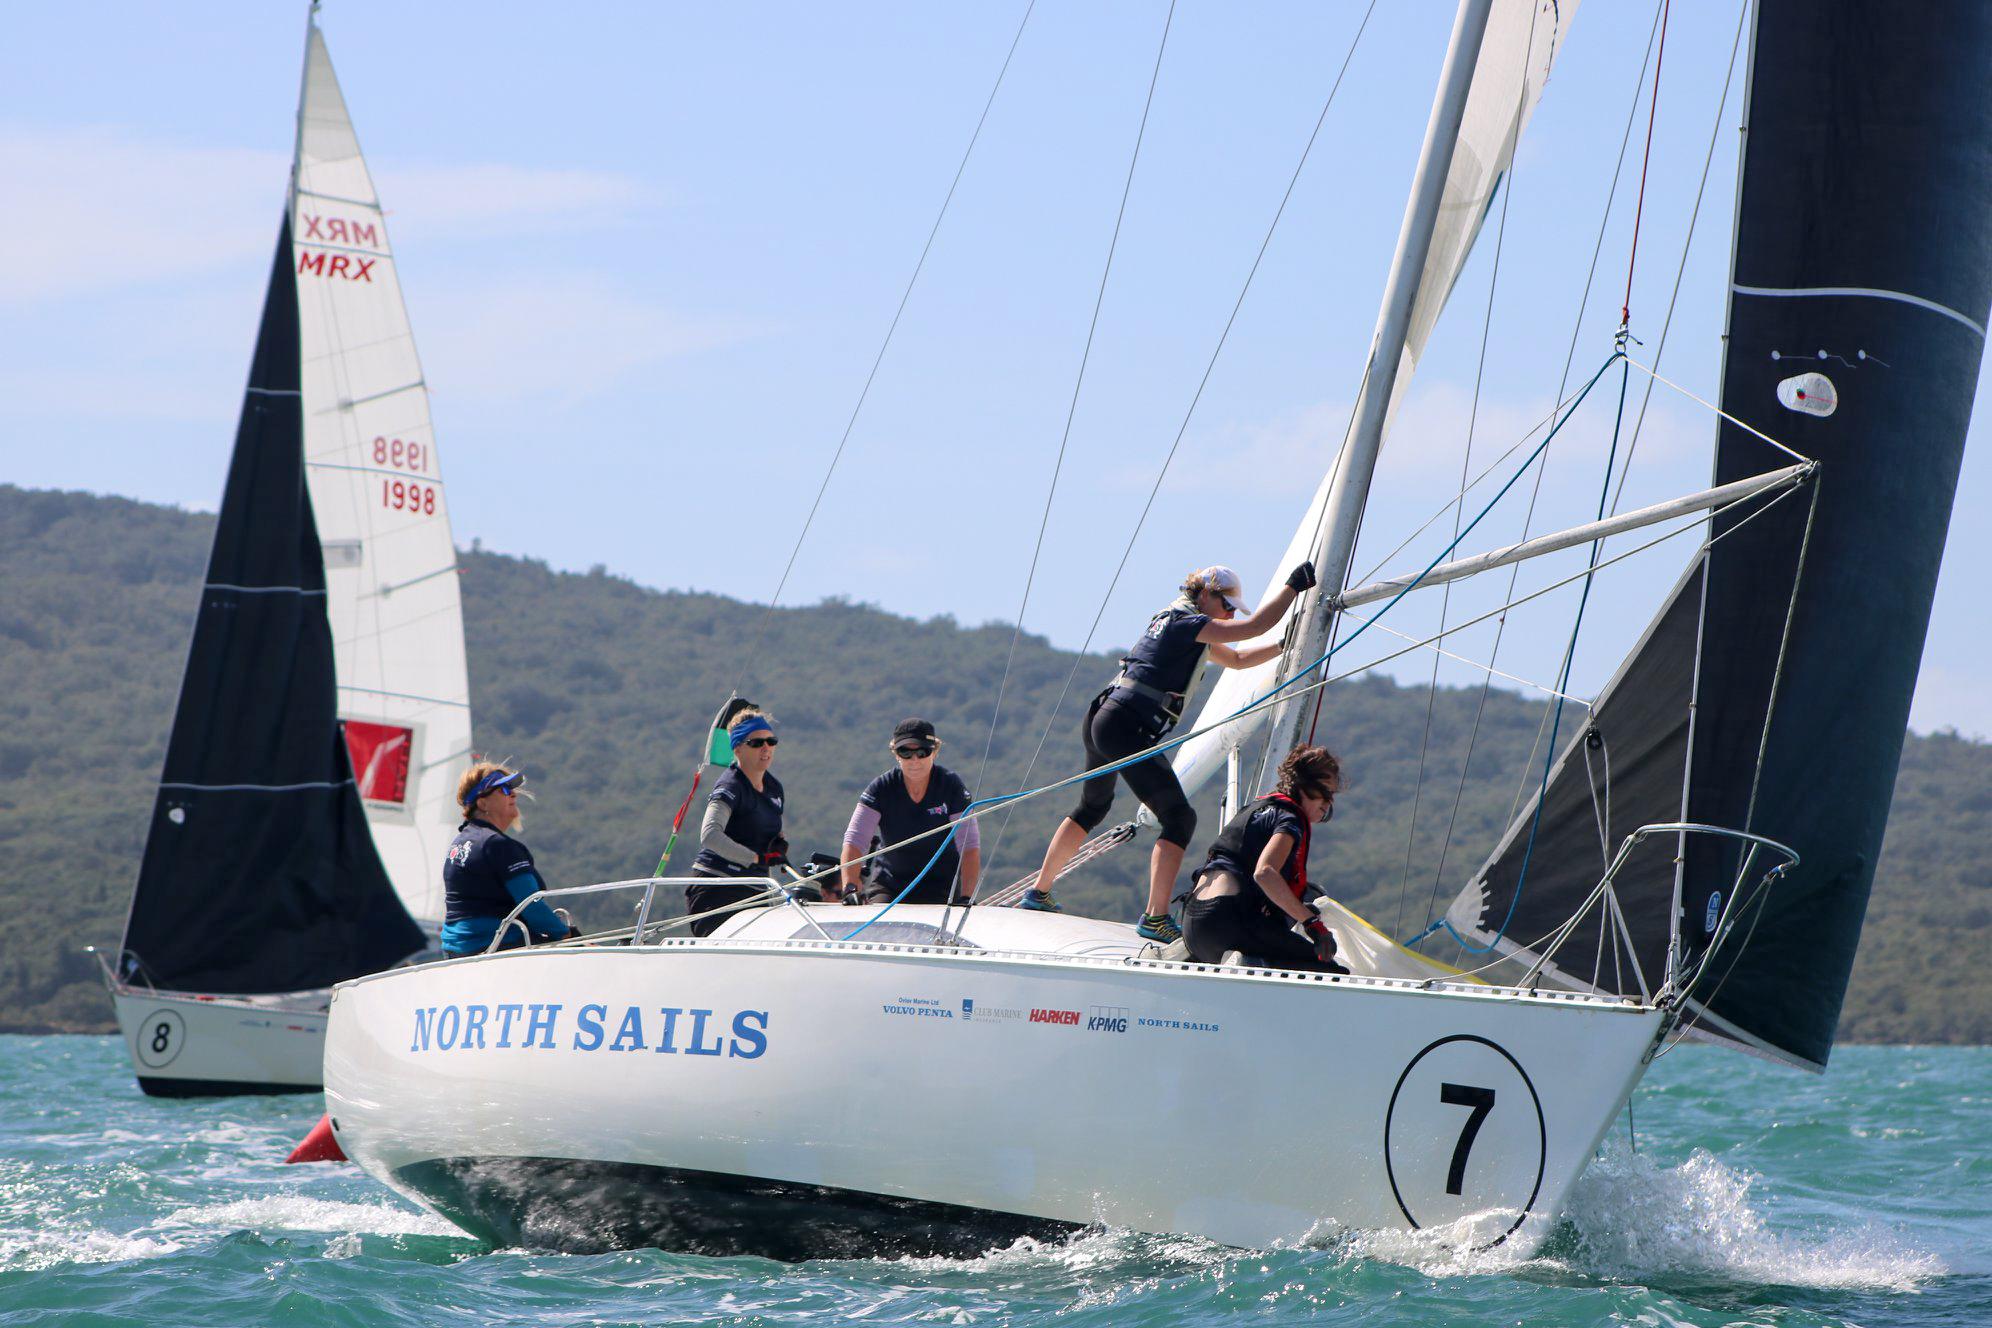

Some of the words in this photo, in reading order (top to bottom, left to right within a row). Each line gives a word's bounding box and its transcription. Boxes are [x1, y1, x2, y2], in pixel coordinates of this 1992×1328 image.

[297, 251, 376, 283] MRX
[383, 479, 436, 515] 1998
[883, 1005, 916, 1016] VOLVO
[917, 1008, 953, 1019] PENTA
[1029, 1008, 1081, 1026] HARKEN
[1087, 1016, 1128, 1033] KPMG
[1138, 1018, 1180, 1029] NORTH
[1183, 1021, 1220, 1032] SAILS
[151, 1022, 171, 1053] 8
[410, 1003, 563, 1052] NORTH
[572, 1003, 770, 1060] SAILS
[1440, 1082, 1496, 1196] 7
